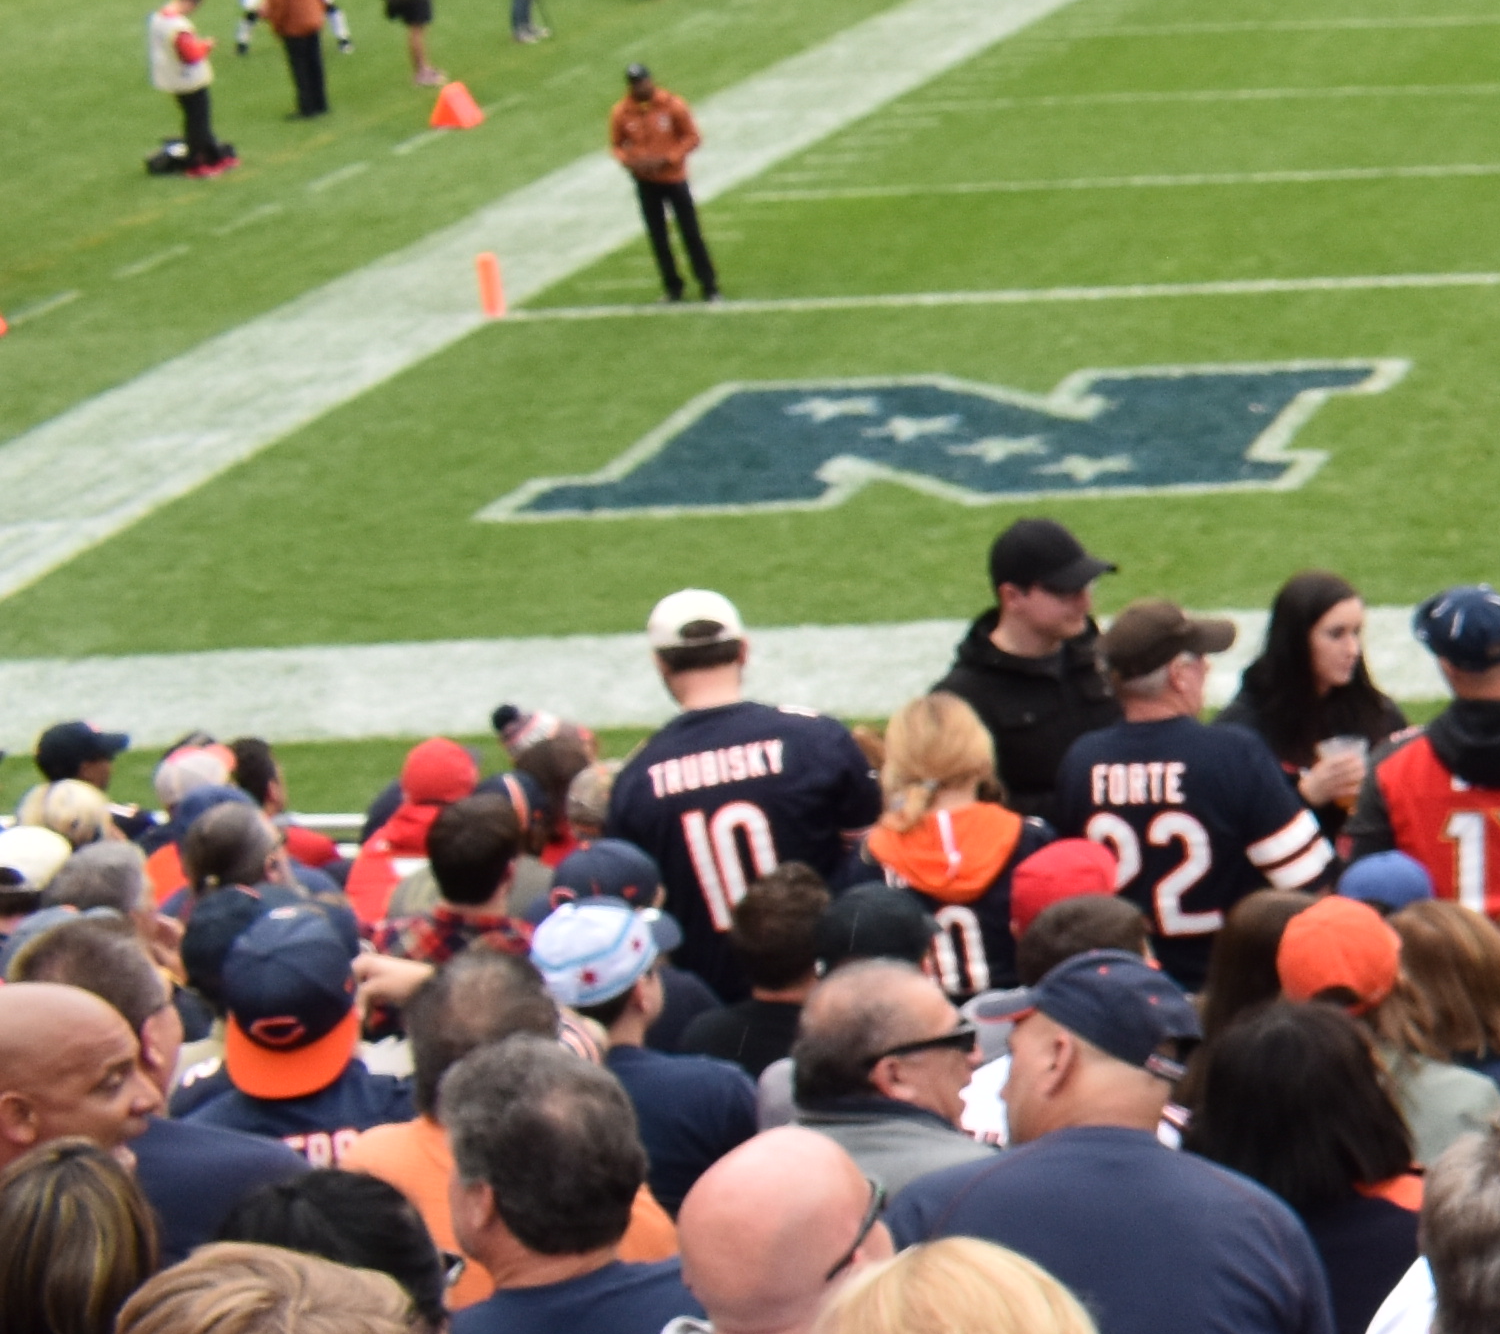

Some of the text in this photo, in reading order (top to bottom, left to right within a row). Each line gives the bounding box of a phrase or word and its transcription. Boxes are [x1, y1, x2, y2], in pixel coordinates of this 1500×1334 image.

[647, 739, 785, 799] TRUBISKY
[1091, 763, 1187, 805] FORTE
[679, 800, 780, 933] 10
